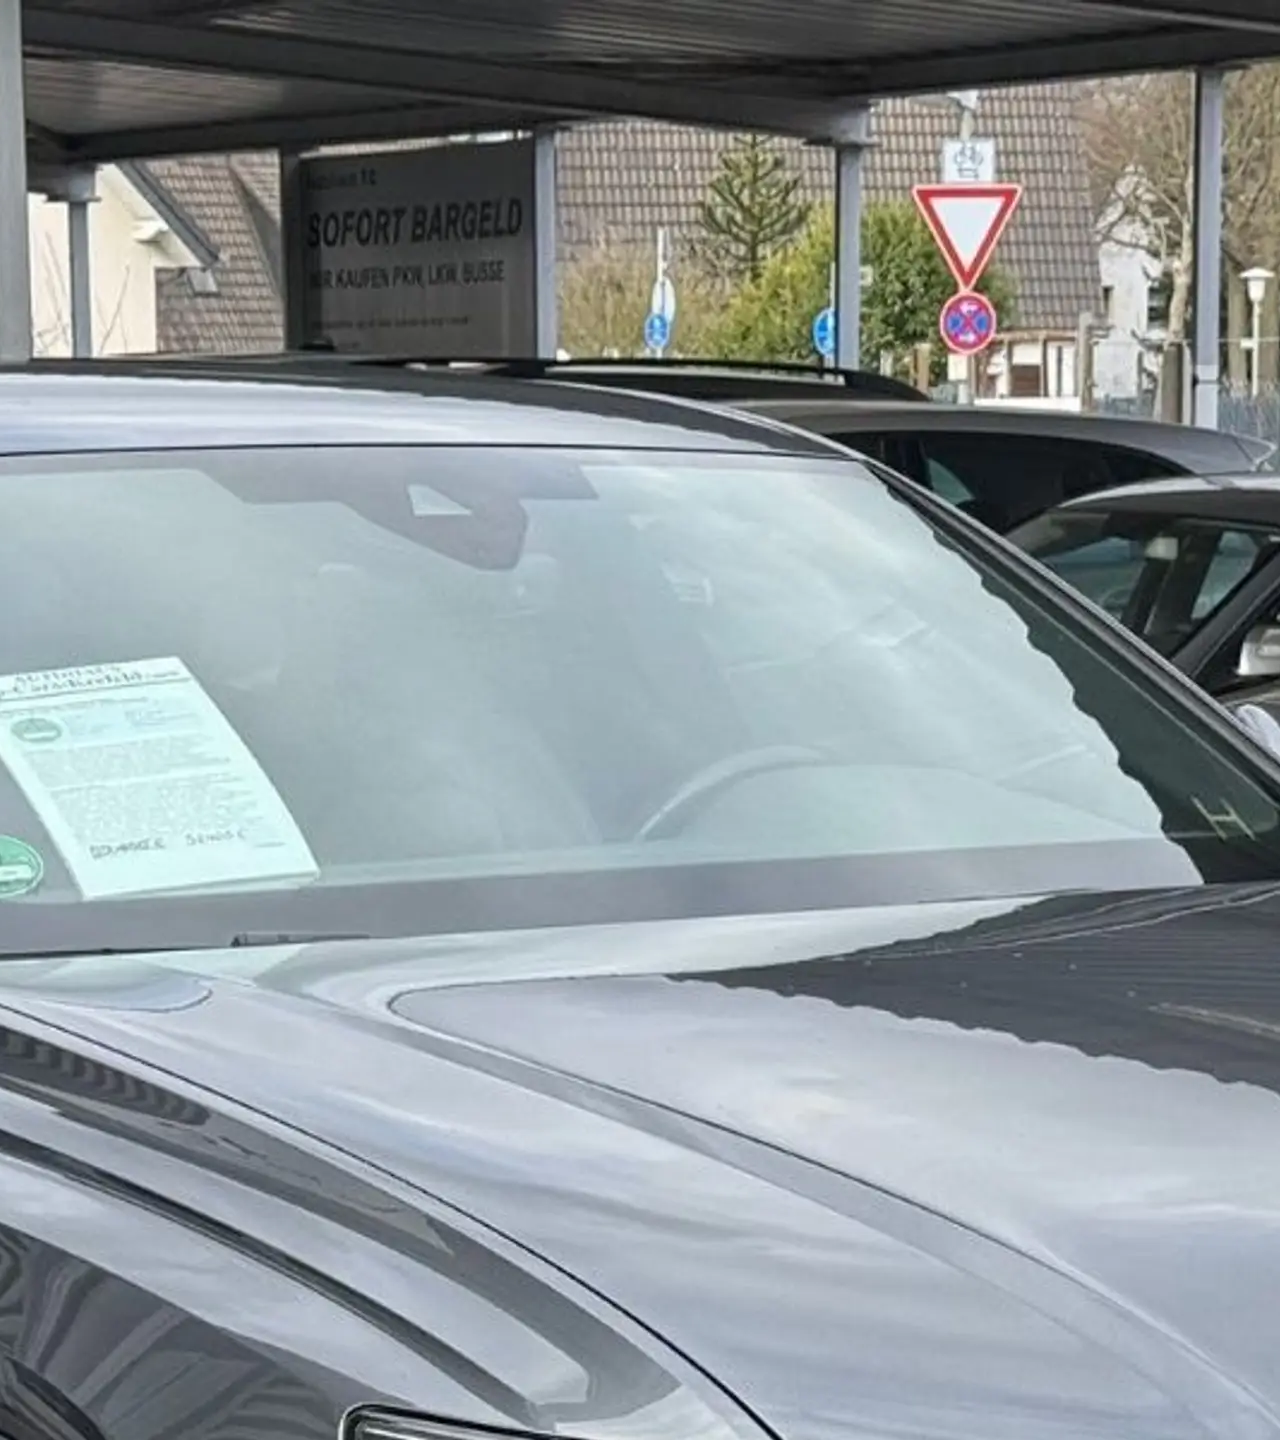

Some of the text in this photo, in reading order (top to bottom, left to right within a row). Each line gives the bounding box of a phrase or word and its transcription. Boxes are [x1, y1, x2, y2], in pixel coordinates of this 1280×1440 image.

[307, 197, 523, 249] SOFORT BARGELD
[335, 265, 390, 289] KAUFEN
[462, 259, 506, 285] BUSSE
